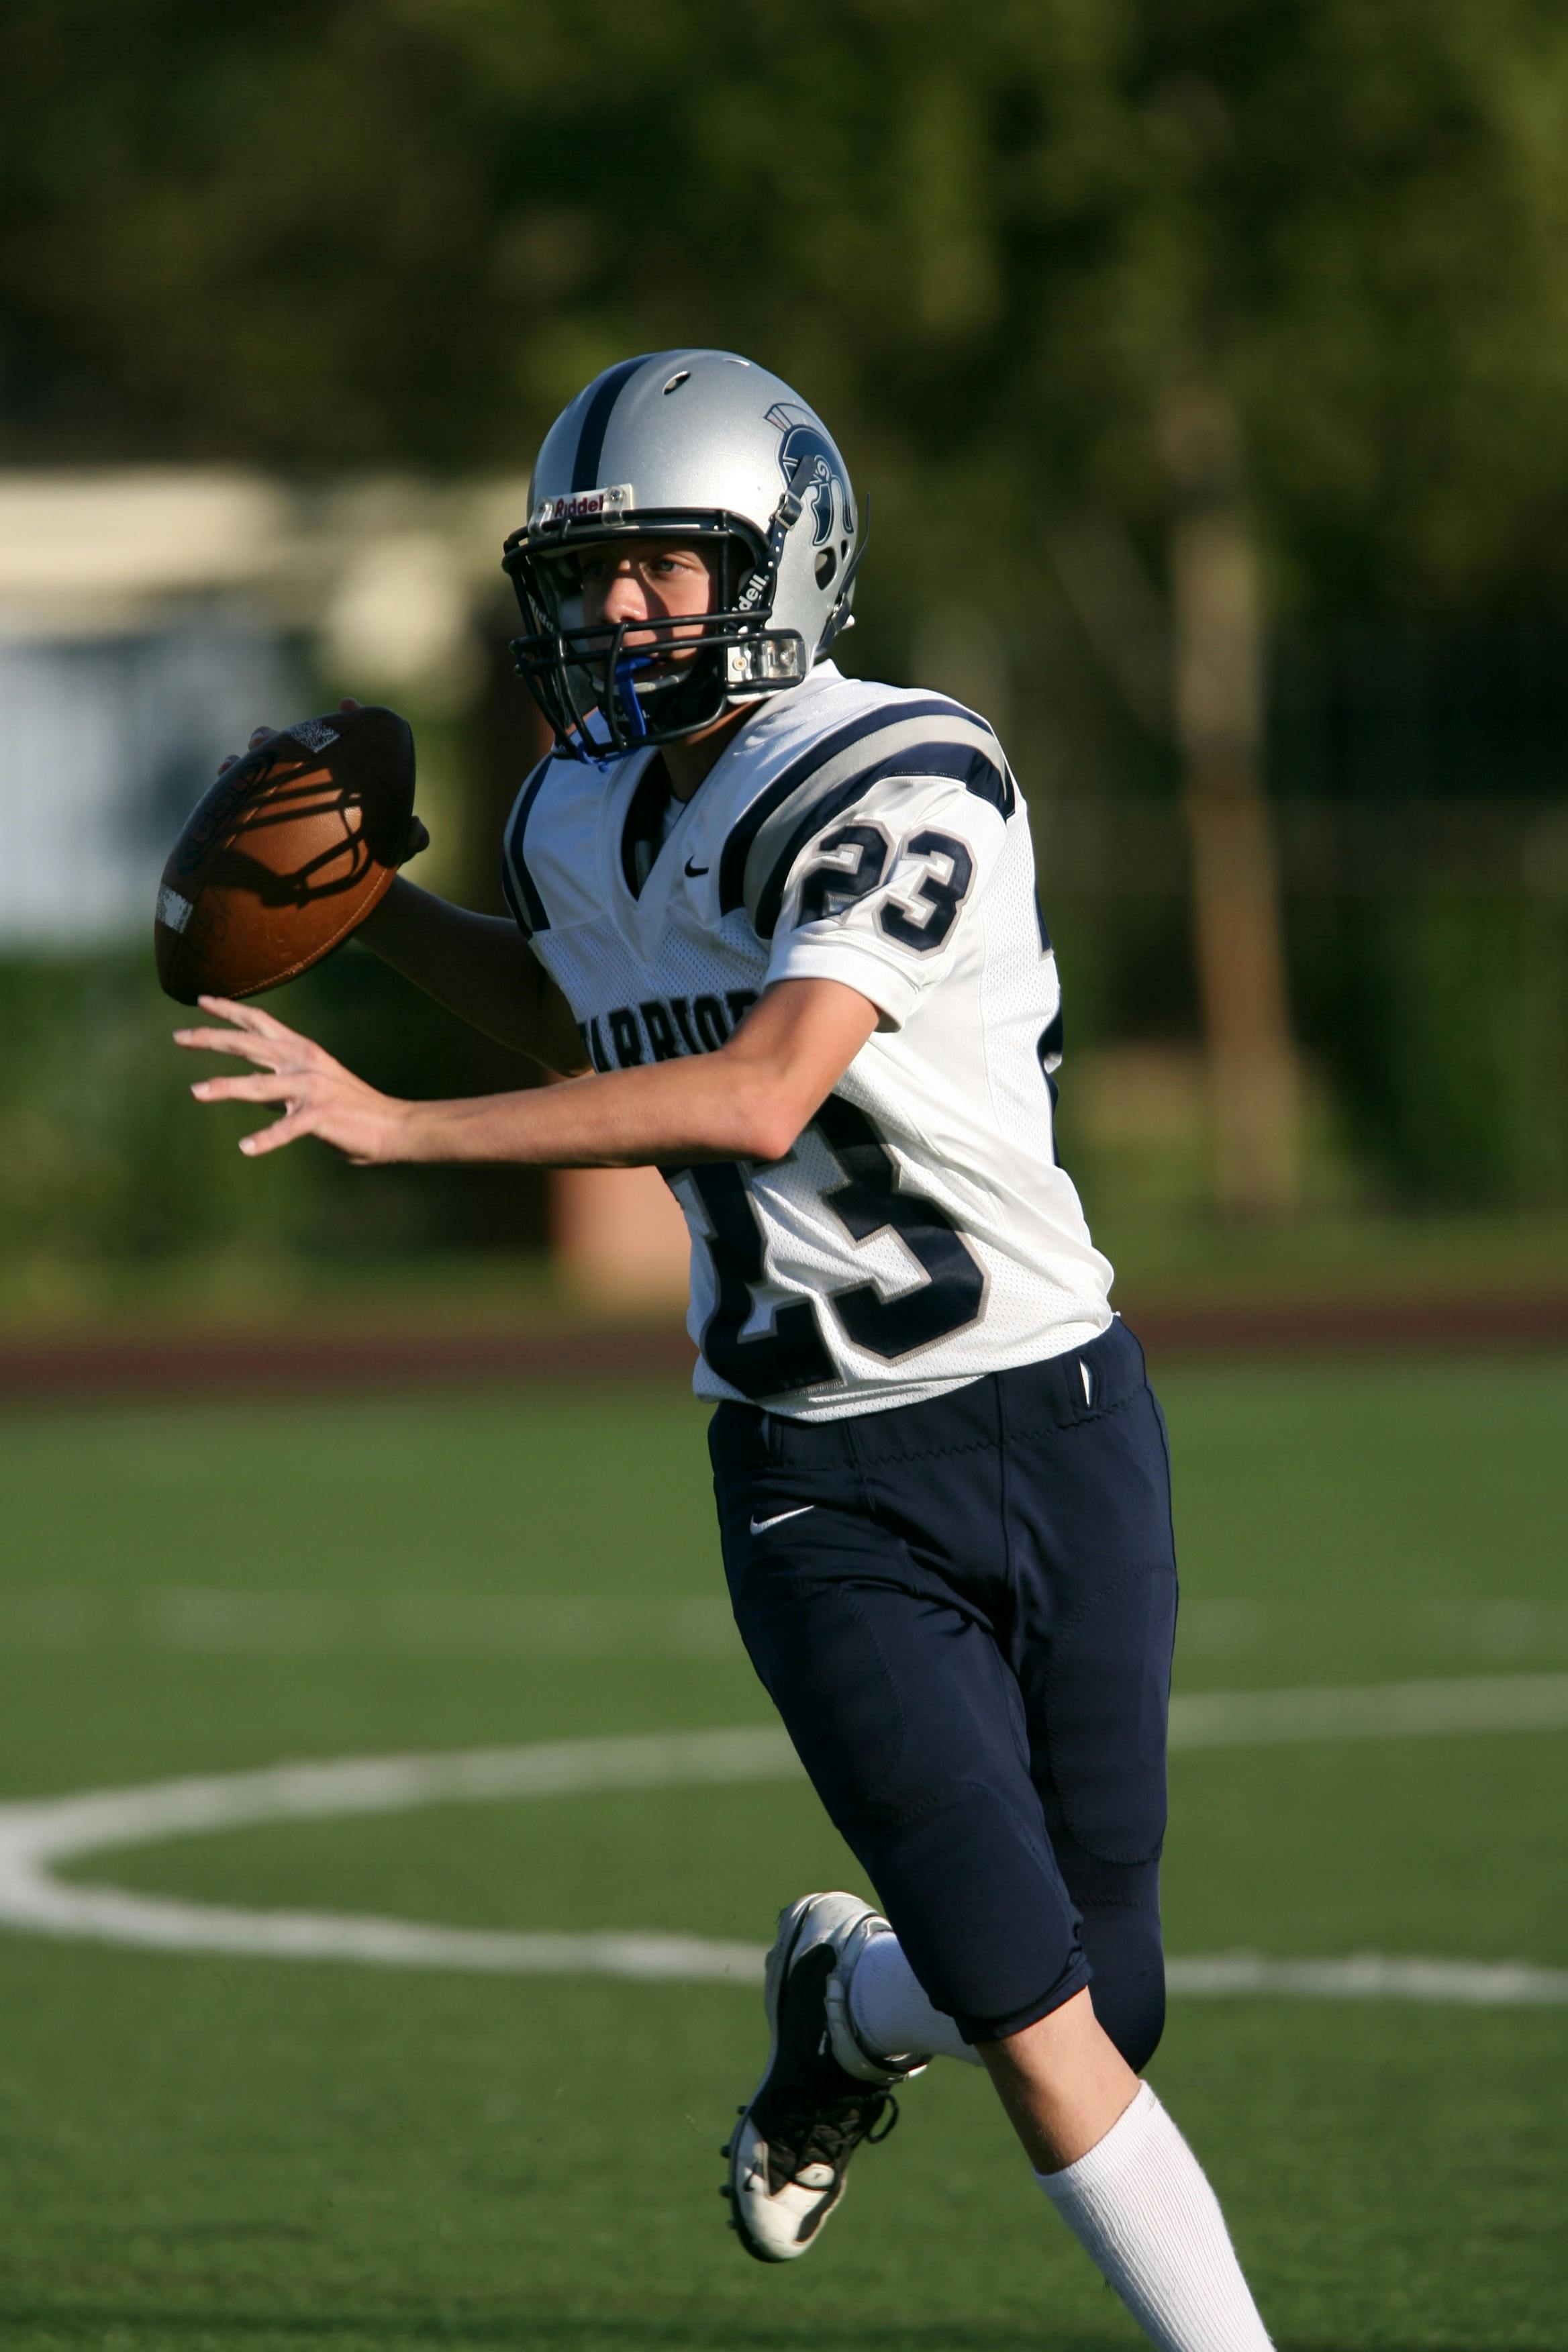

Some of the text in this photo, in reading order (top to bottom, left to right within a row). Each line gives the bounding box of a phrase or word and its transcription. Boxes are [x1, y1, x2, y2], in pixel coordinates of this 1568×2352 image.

[554, 495, 604, 518] Riddel
[794, 818, 977, 961] 23
[578, 988, 763, 1073] ARRIO
[660, 1094, 991, 1400] 23
